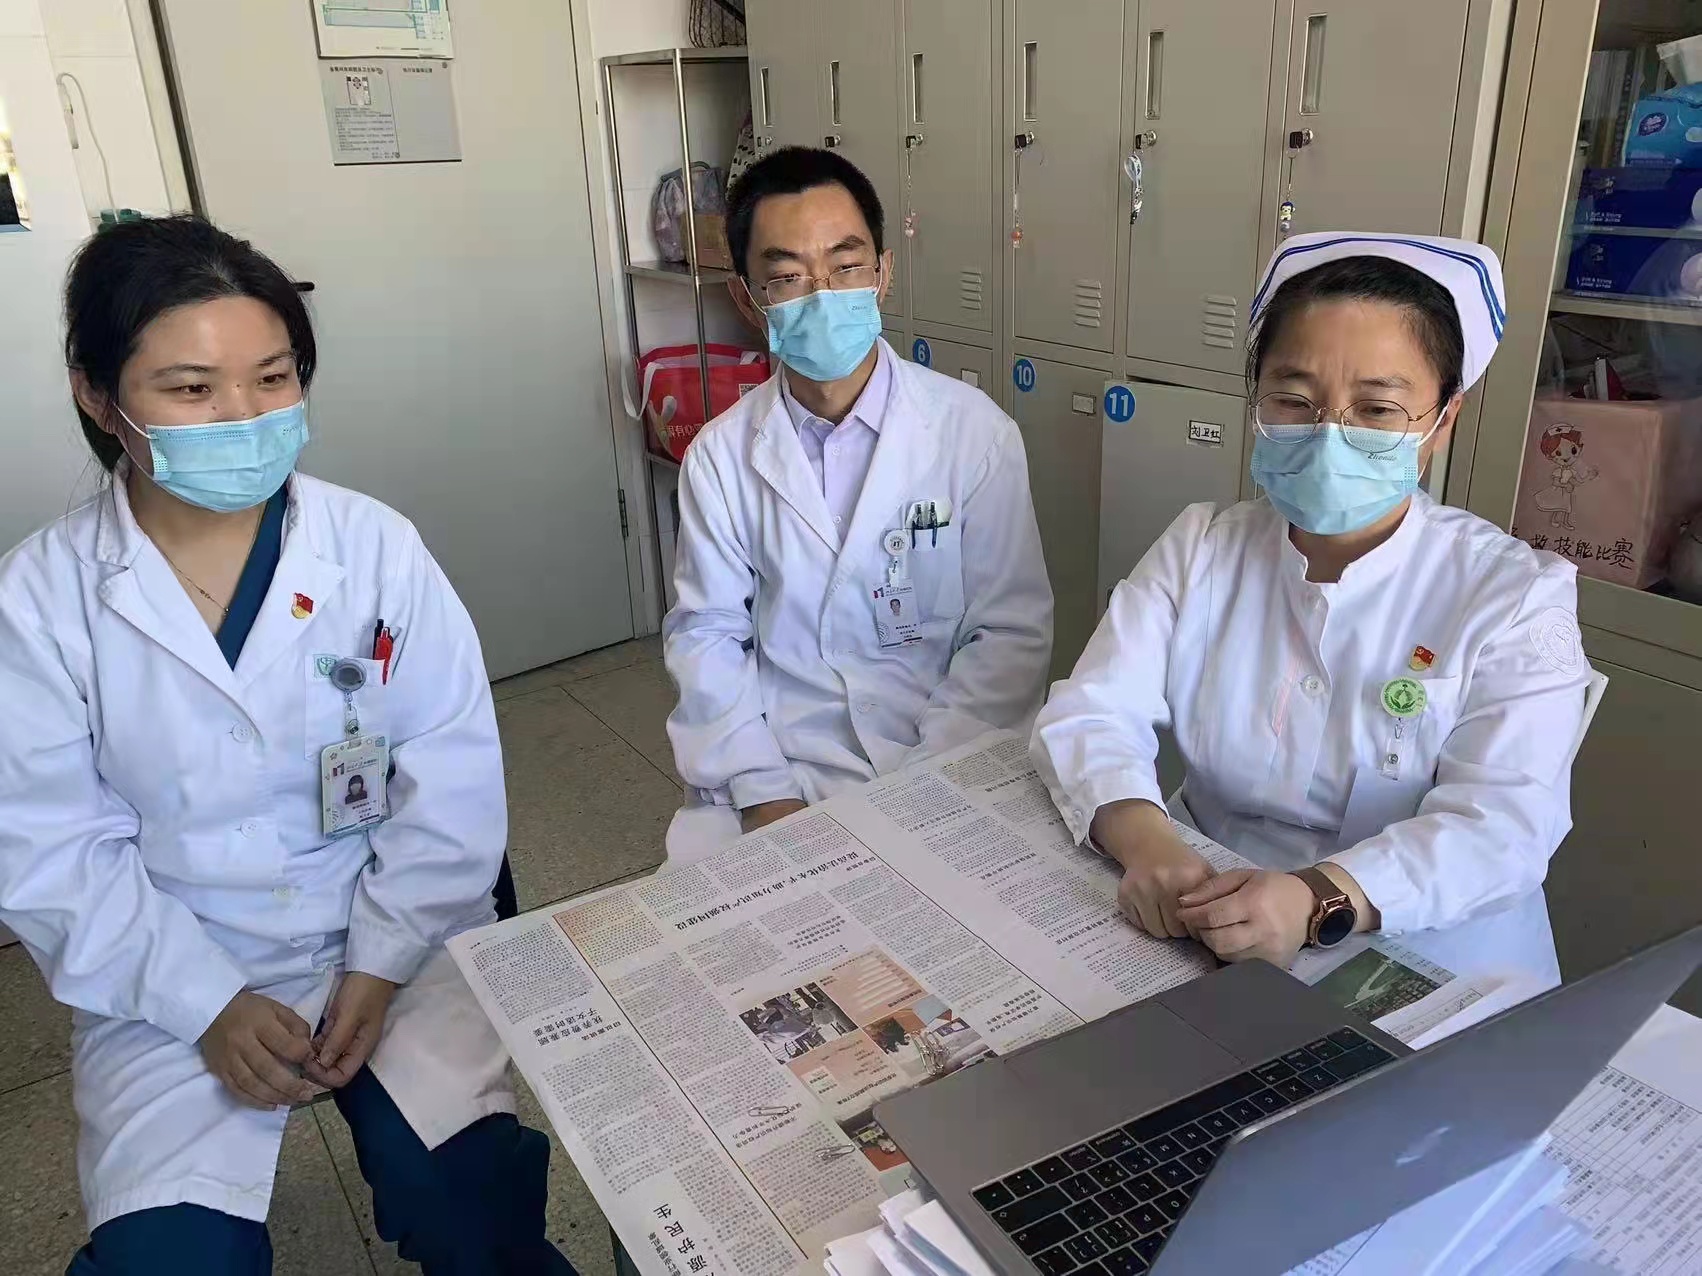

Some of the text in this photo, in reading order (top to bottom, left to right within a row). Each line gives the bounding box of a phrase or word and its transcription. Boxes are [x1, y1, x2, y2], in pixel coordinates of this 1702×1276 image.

[918, 343, 926, 362] 6
[1016, 364, 1032, 387] 10
[1109, 392, 1129, 416] 11
[653, 1203, 715, 1276] 源护民生
